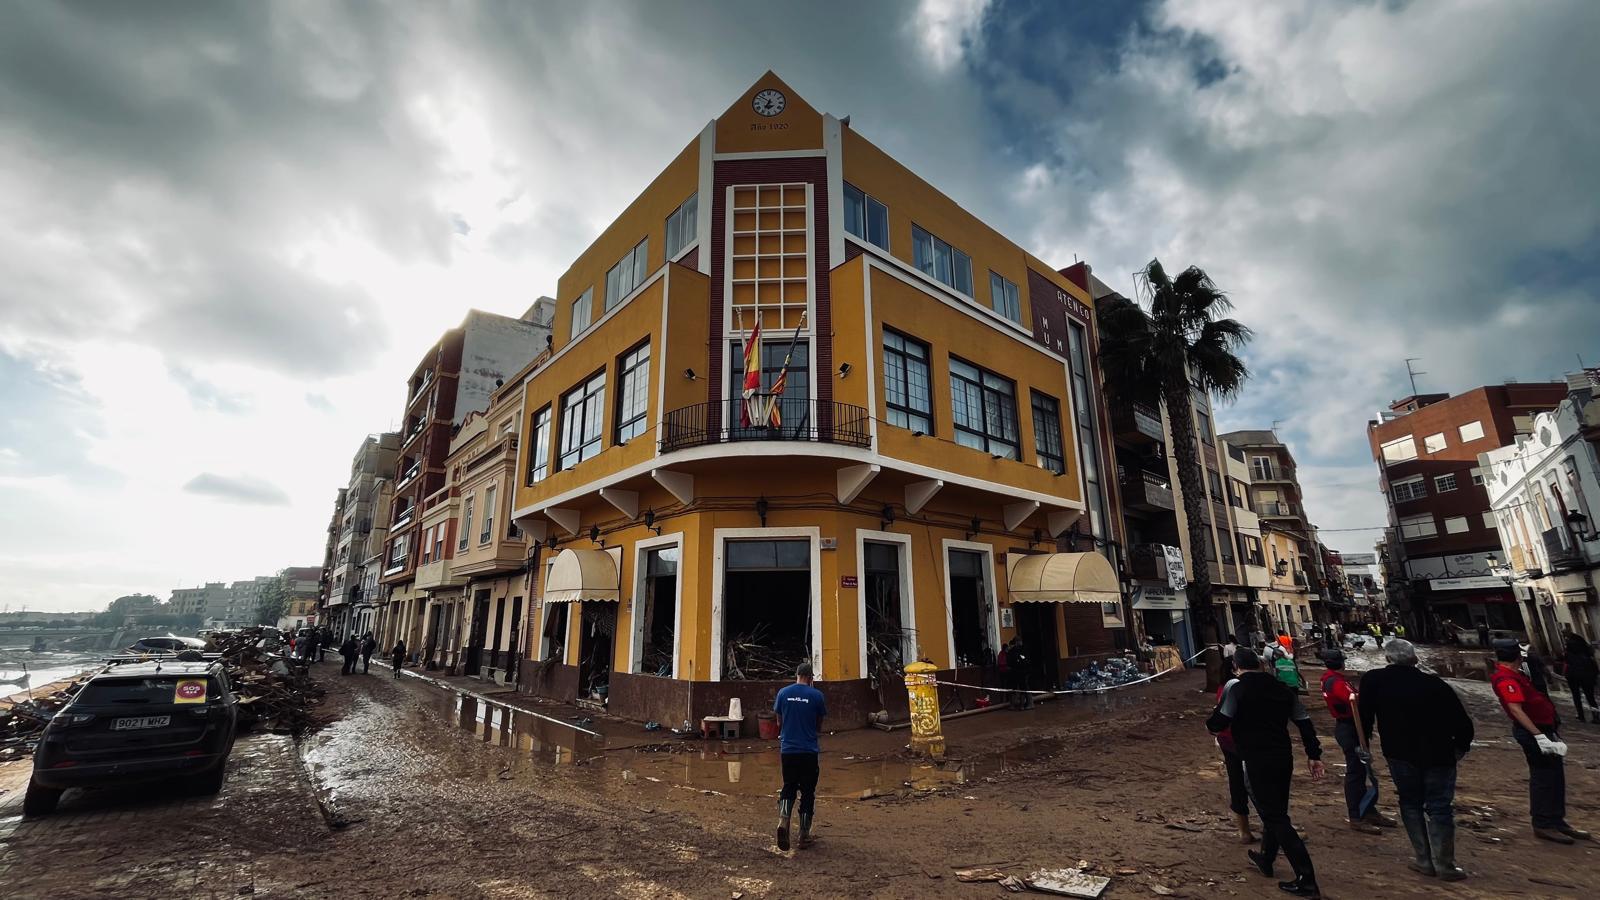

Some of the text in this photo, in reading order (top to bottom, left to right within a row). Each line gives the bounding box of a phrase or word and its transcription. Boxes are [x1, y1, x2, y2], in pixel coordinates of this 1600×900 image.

[769, 122, 789, 130] 1920
[1057, 290, 1090, 320] ATENEO
[119, 718, 144, 729] 9021
